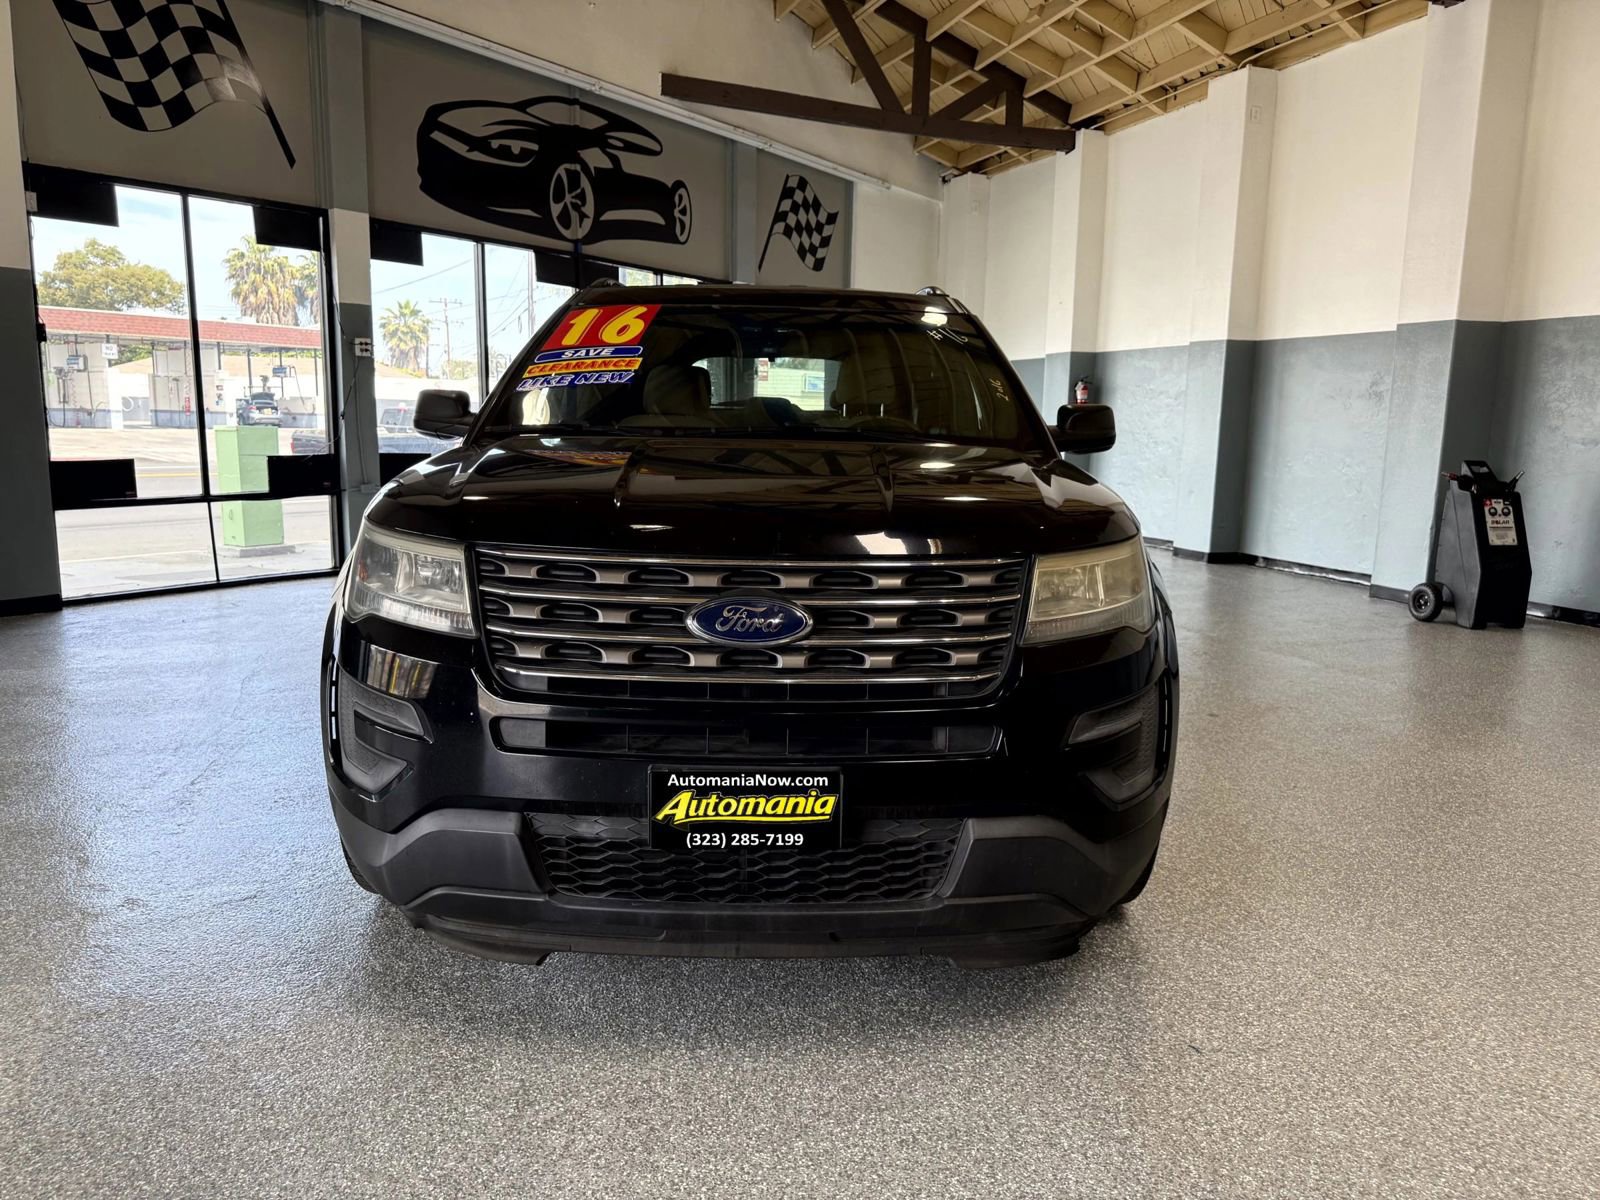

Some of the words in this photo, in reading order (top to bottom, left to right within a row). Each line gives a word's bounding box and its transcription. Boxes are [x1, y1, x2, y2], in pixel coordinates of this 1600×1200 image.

[561, 305, 648, 346] 16
[561, 348, 615, 358] SAVE
[526, 358, 639, 376] CLEARANCE
[515, 374, 575, 391] LIKE
[574, 371, 635, 385] NEW
[715, 605, 785, 632] Ford
[667, 774, 829, 787] AutomaniaNow.com
[653, 789, 839, 824] Automania
[686, 833, 726, 849] (323)
[731, 834, 804, 847] 285-7199
